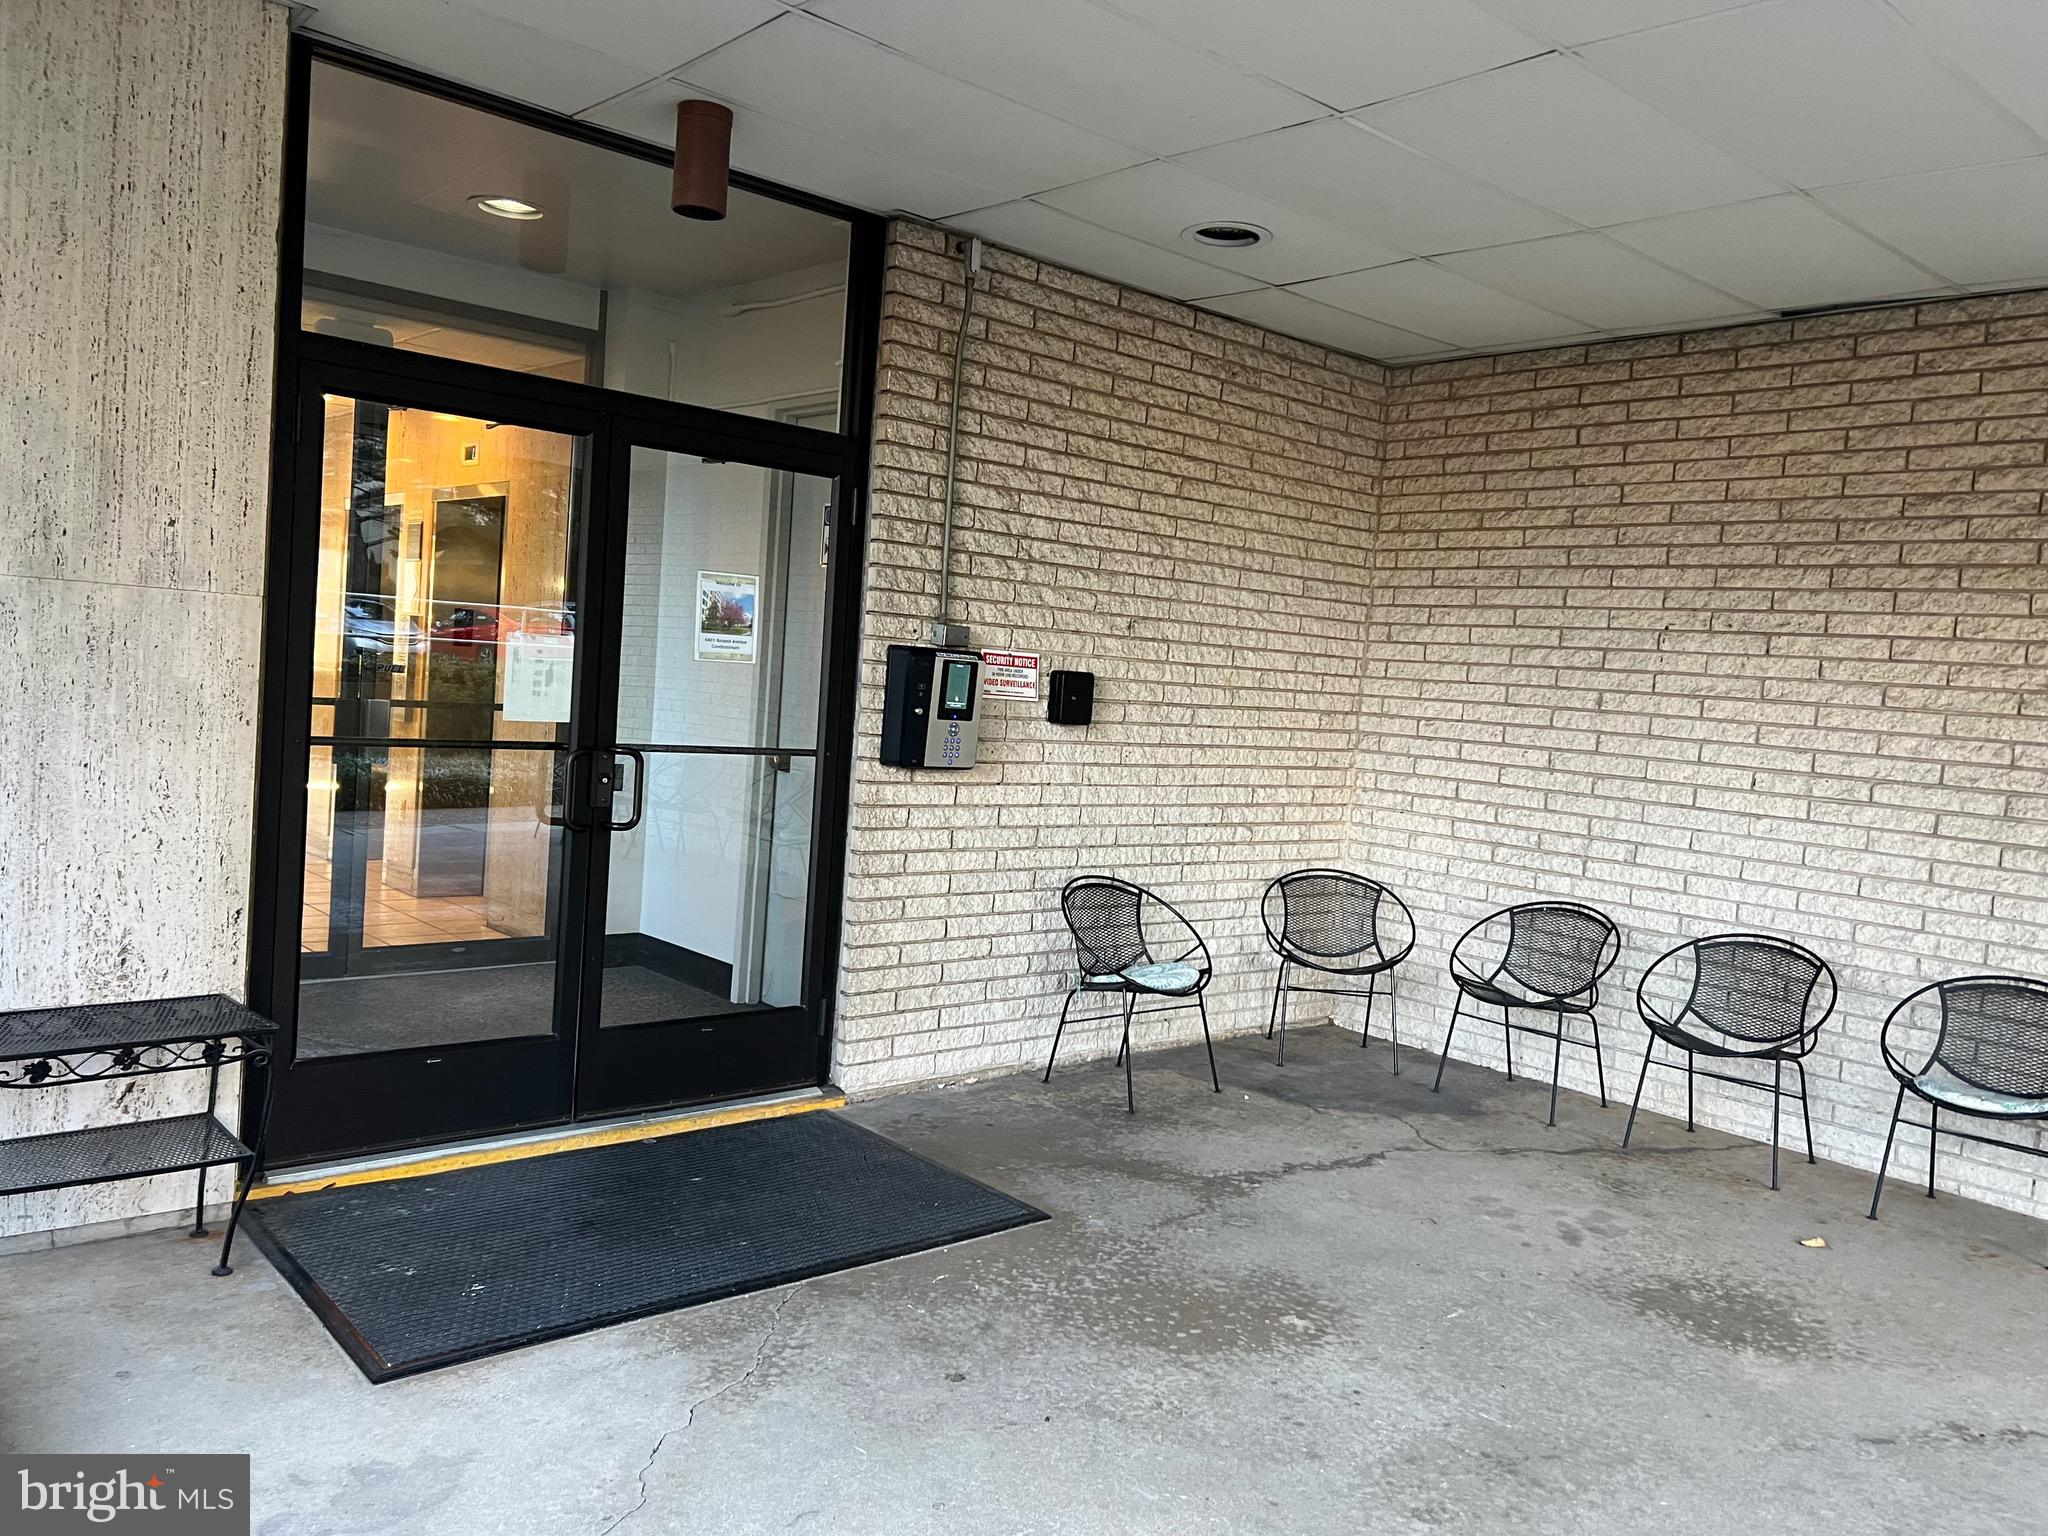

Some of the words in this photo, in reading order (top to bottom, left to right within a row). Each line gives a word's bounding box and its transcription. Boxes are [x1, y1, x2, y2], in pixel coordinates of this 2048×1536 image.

[985, 655, 1013, 666] SECURITY
[1014, 657, 1036, 668] NOTICE
[984, 678, 999, 686] VIDEO
[1000, 679, 1036, 689] SURVEILLANCE
